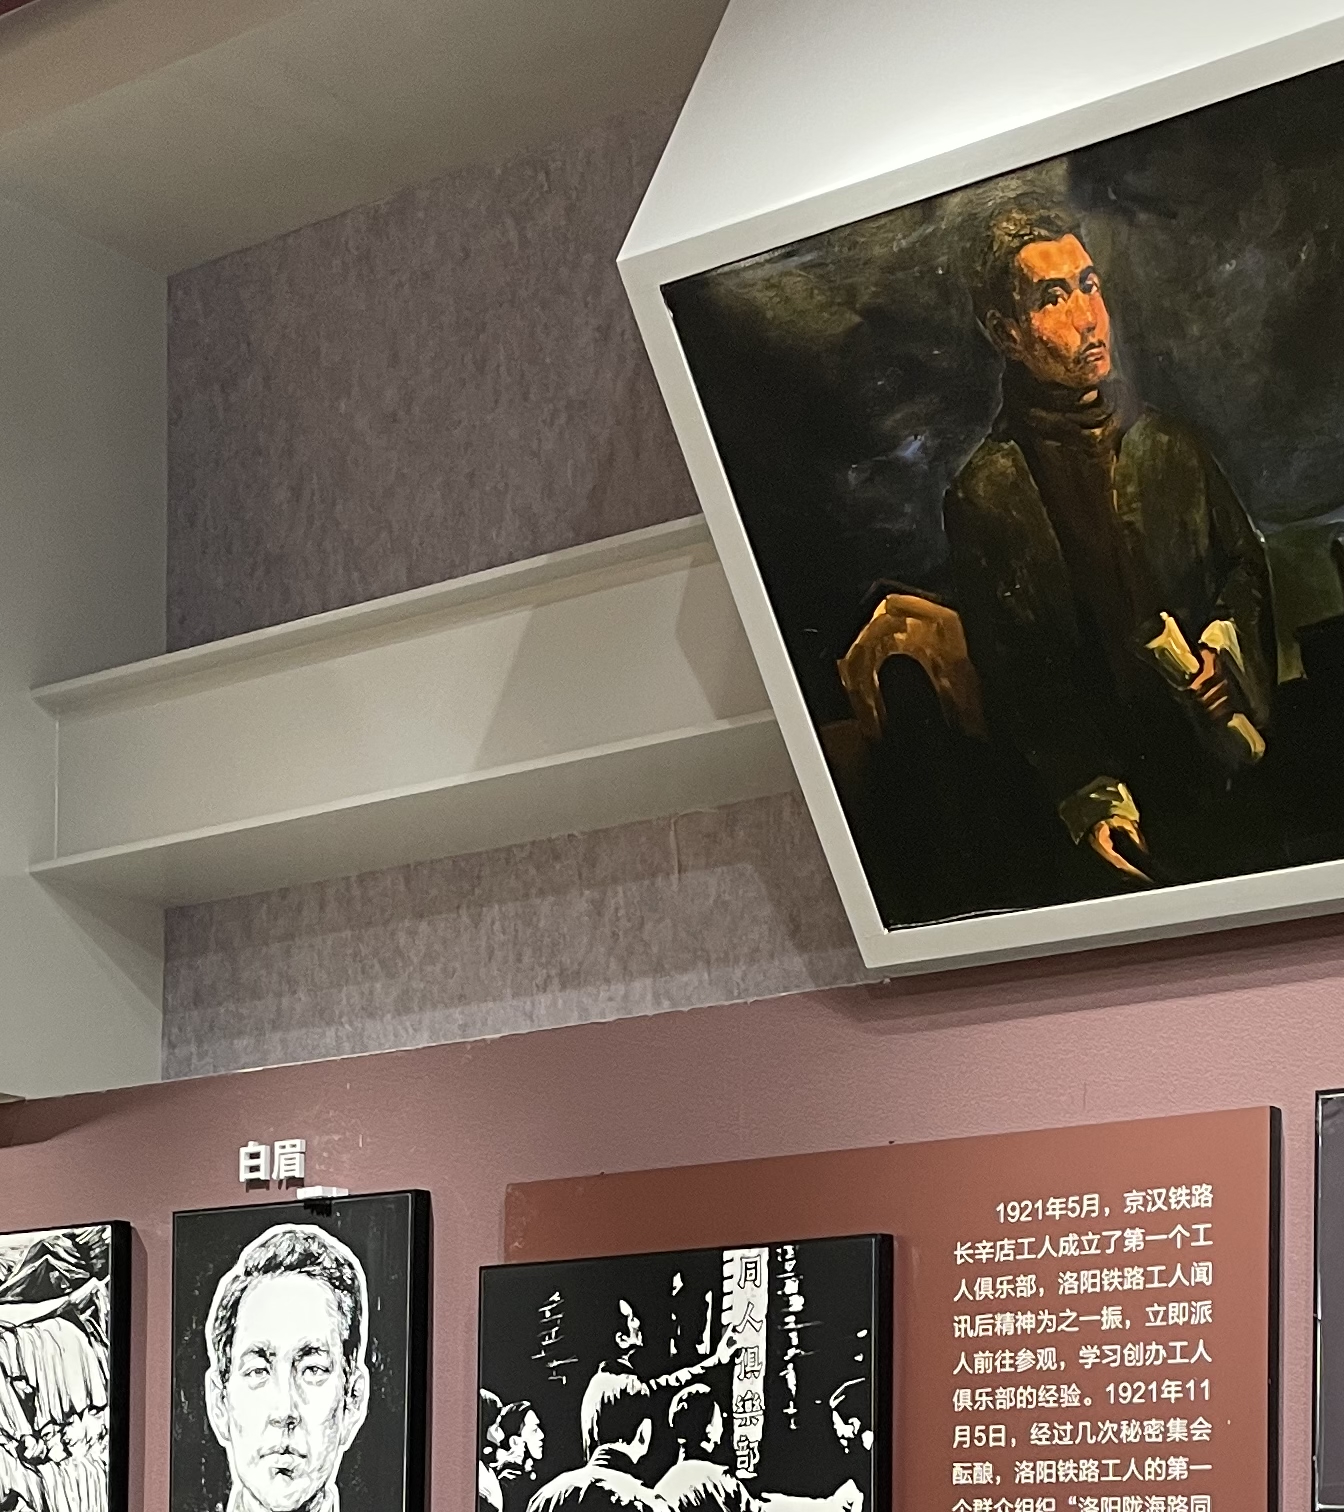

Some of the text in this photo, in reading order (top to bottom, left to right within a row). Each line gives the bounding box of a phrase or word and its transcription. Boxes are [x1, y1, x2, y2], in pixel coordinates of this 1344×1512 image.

[239, 1139, 306, 1182] 白眉
[995, 1183, 1214, 1225] 1921年5月，京汉铁路
[953, 1224, 1214, 1264] 长辛店工人成立了第一个工
[953, 1261, 1213, 1302] 人俱乐部，洛阳铁路工人闻
[953, 1300, 1213, 1338] 讯后精神为之一振，立即派
[736, 1255, 764, 1472] 同人俱樂部
[952, 1339, 1213, 1374] 人前往参观，学习创办工人
[952, 1378, 1211, 1411] 俱乐部的经验。1921年11
[952, 1416, 1212, 1448] 月5日，经过几次秘密集会
[952, 1455, 1212, 1485] 酝酿，洛阳铁路工人的第一
